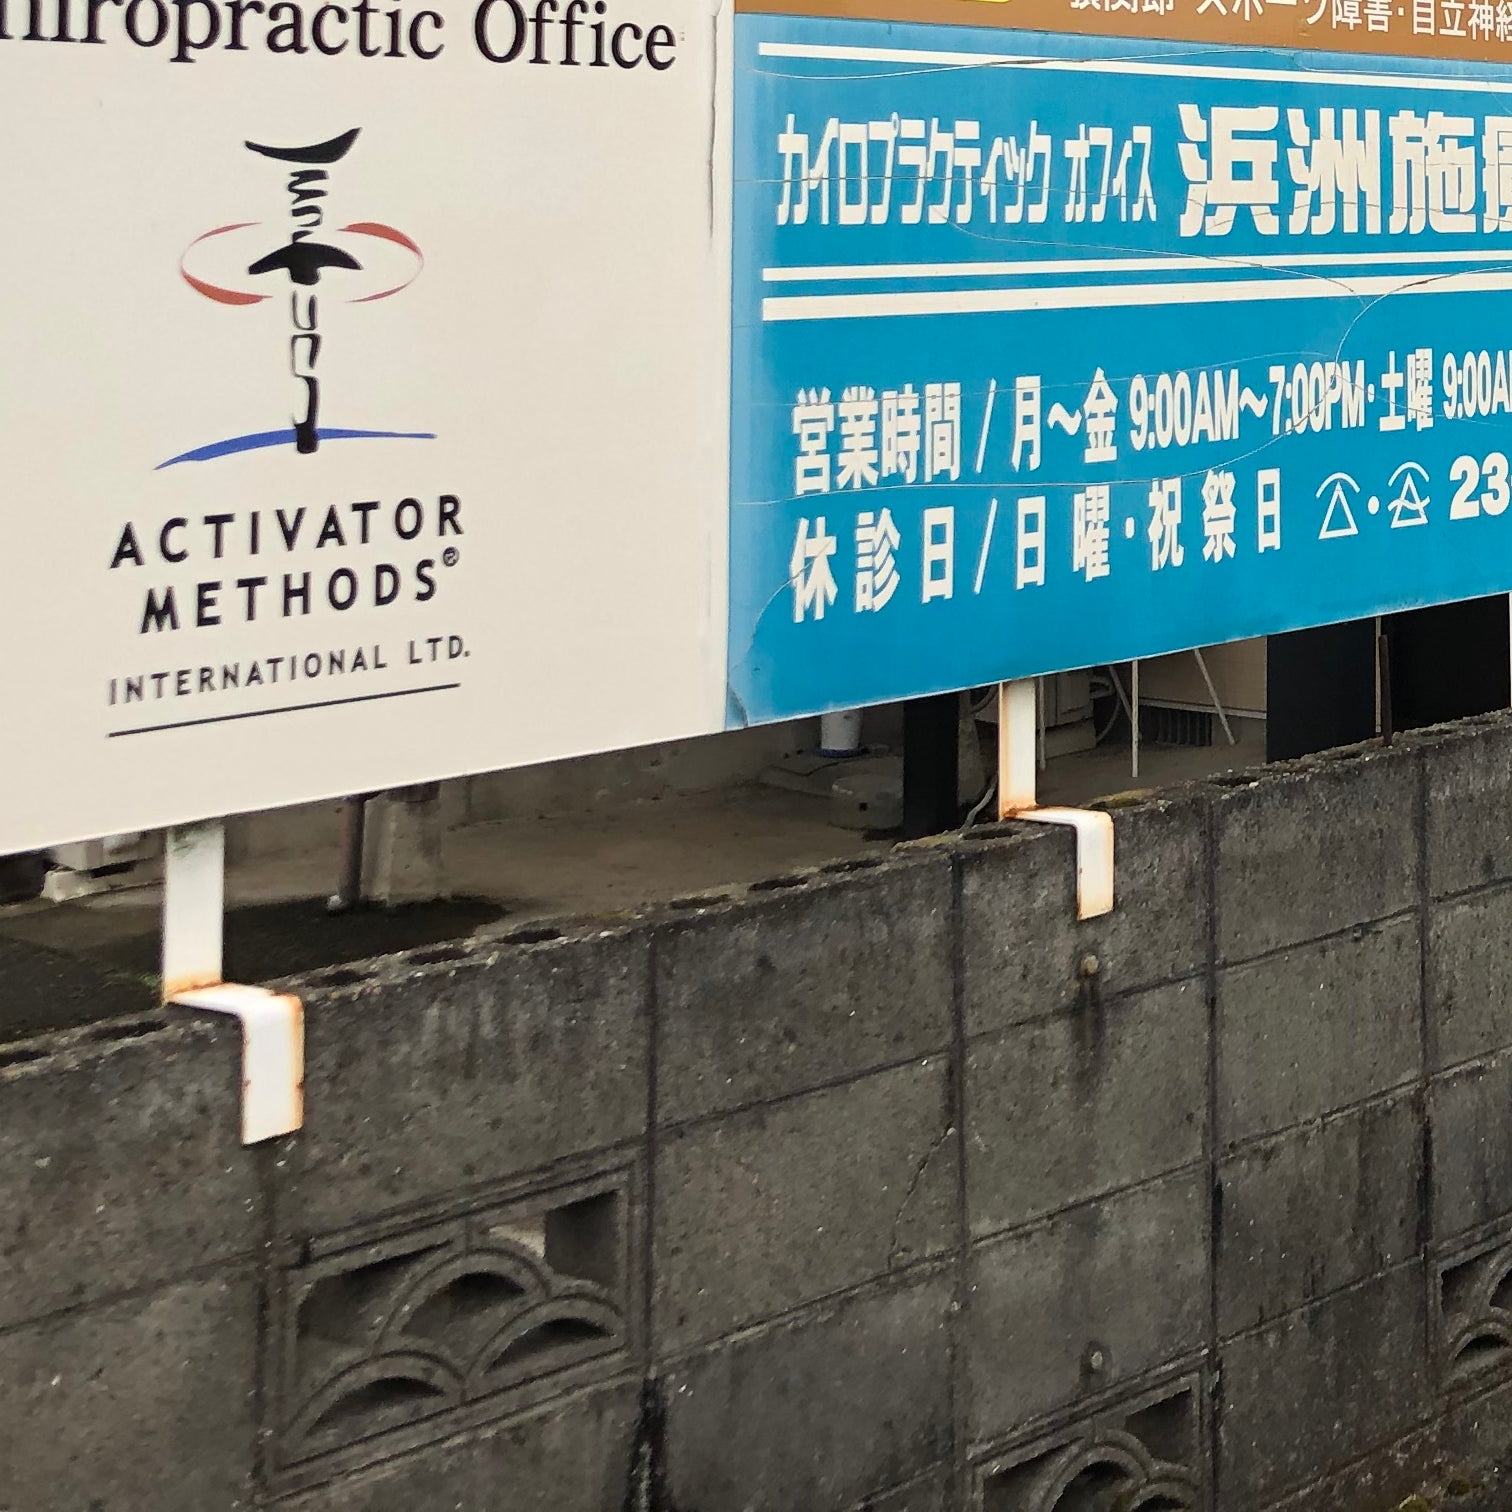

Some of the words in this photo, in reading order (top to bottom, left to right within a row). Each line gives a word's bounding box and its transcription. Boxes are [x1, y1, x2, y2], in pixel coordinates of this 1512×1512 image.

[776, 111, 1052, 226] カイロプラクティック
[1063, 123, 1157, 223] オフィス
[109, 494, 465, 569] ACTIVATOR
[109, 644, 388, 706] INTERNATIONAL
[409, 634, 471, 666] LTD.
